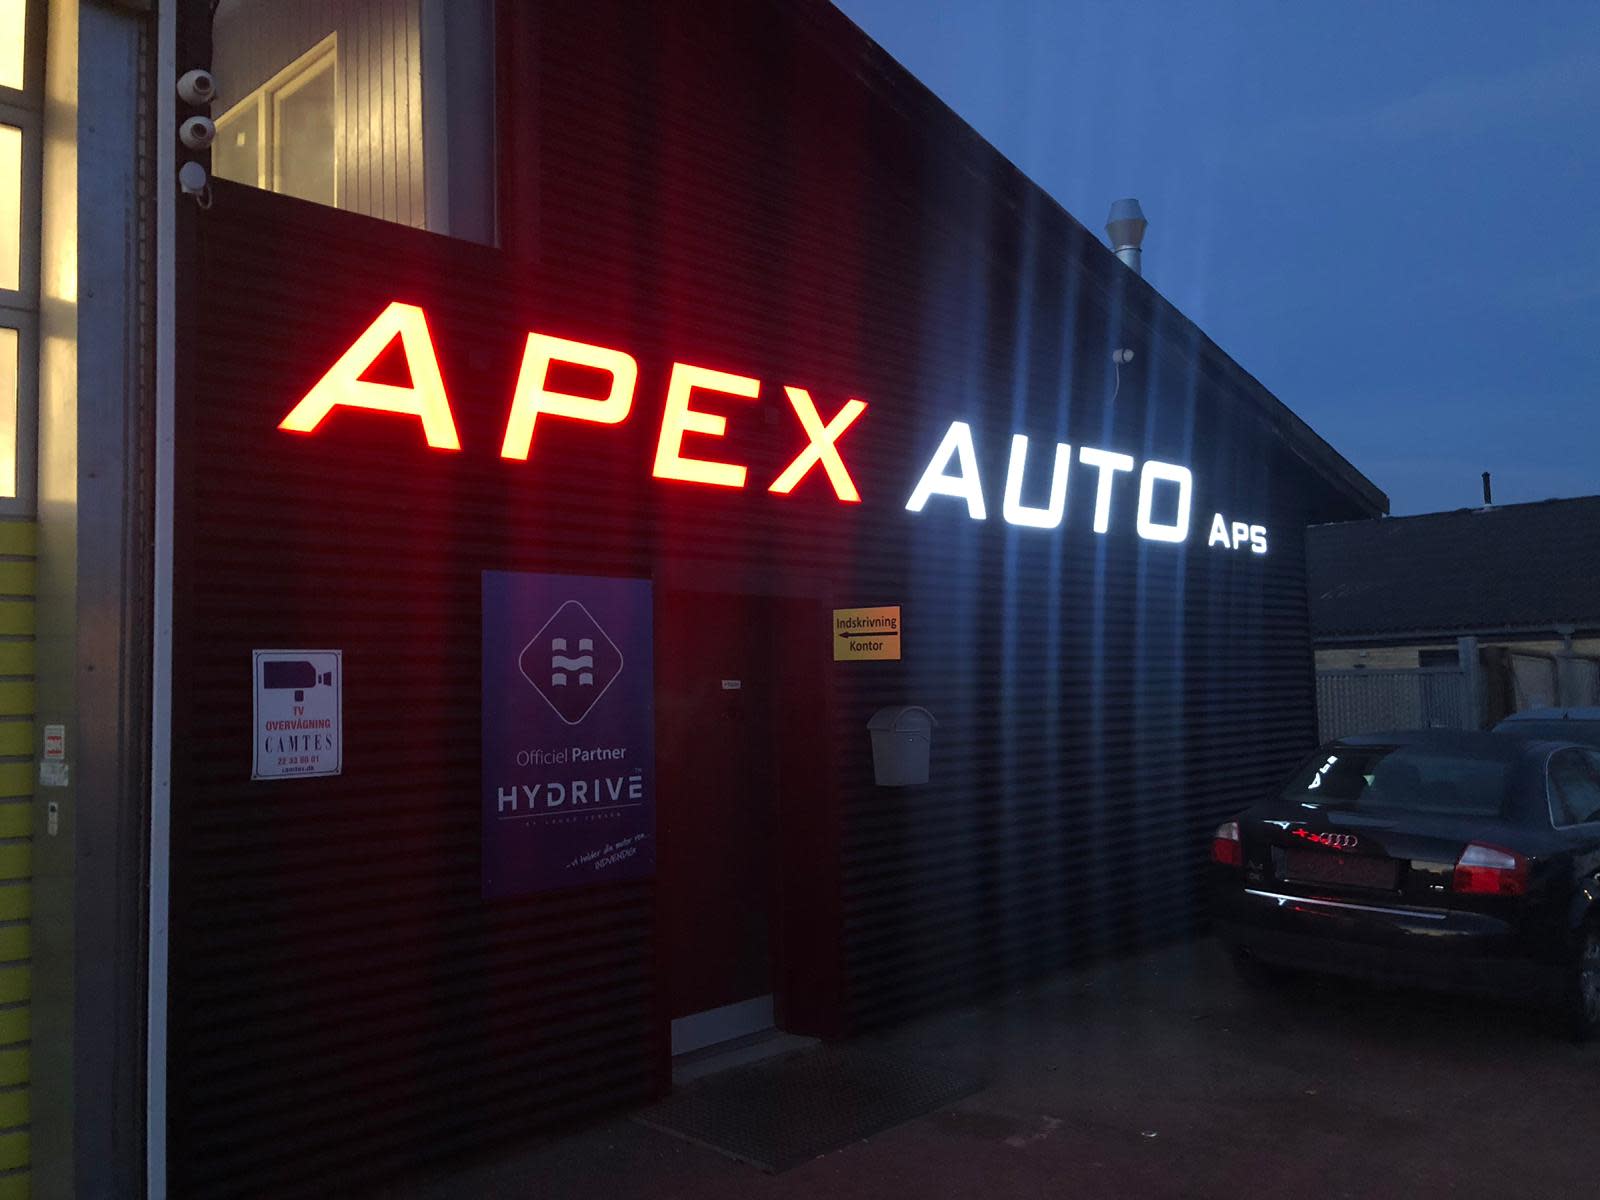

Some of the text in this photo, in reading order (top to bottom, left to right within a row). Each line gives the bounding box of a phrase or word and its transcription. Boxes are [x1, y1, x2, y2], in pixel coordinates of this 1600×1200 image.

[277, 301, 1268, 554] APEX AUTO APS
[836, 616, 897, 629] Indskrivning
[849, 640, 884, 652] Kontor
[293, 706, 305, 716] TV
[265, 718, 331, 732] OVERVÅGNING
[265, 734, 333, 753] CAMTES
[516, 747, 627, 767] Officiel Partner
[497, 775, 643, 812] HYDRIVE
